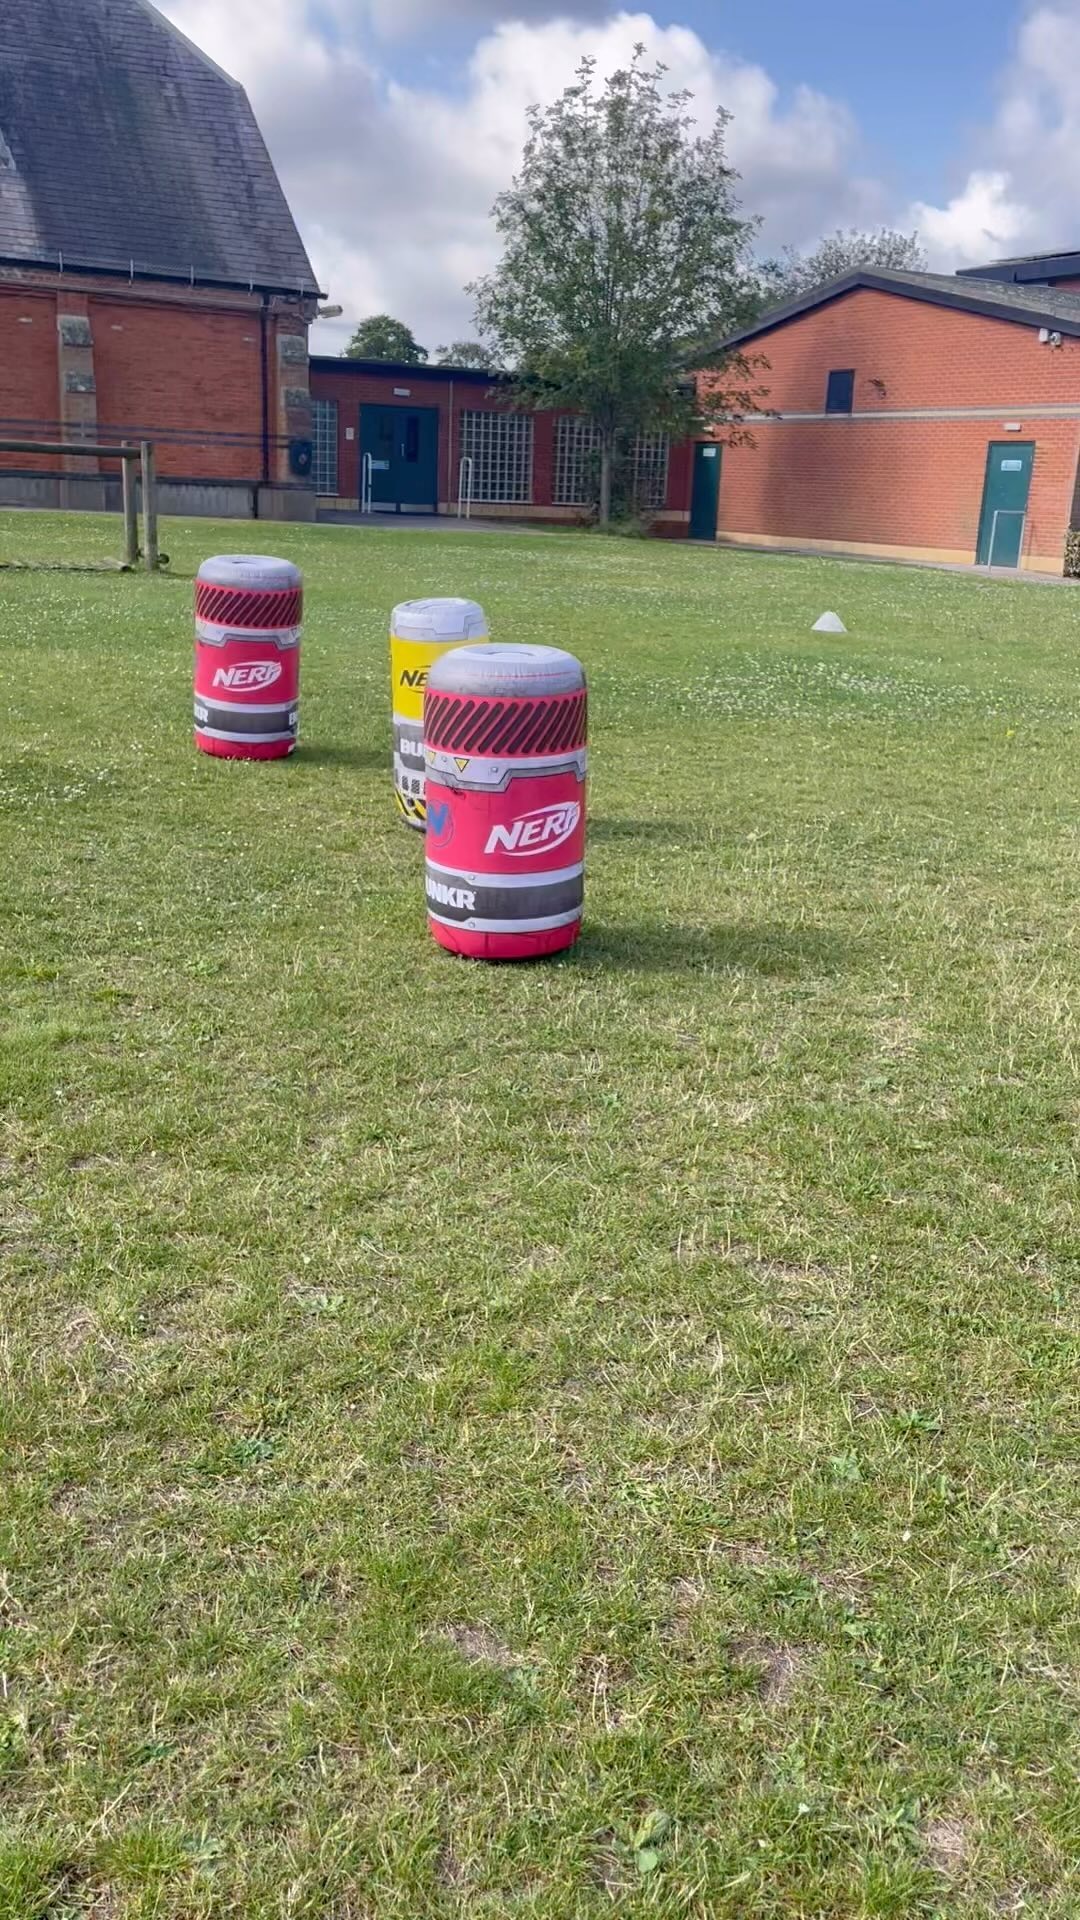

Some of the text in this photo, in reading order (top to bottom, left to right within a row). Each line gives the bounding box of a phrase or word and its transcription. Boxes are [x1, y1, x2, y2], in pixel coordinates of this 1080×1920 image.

[212, 662, 282, 690] NERF
[399, 669, 428, 687] NE
[484, 801, 580, 855] NERF
